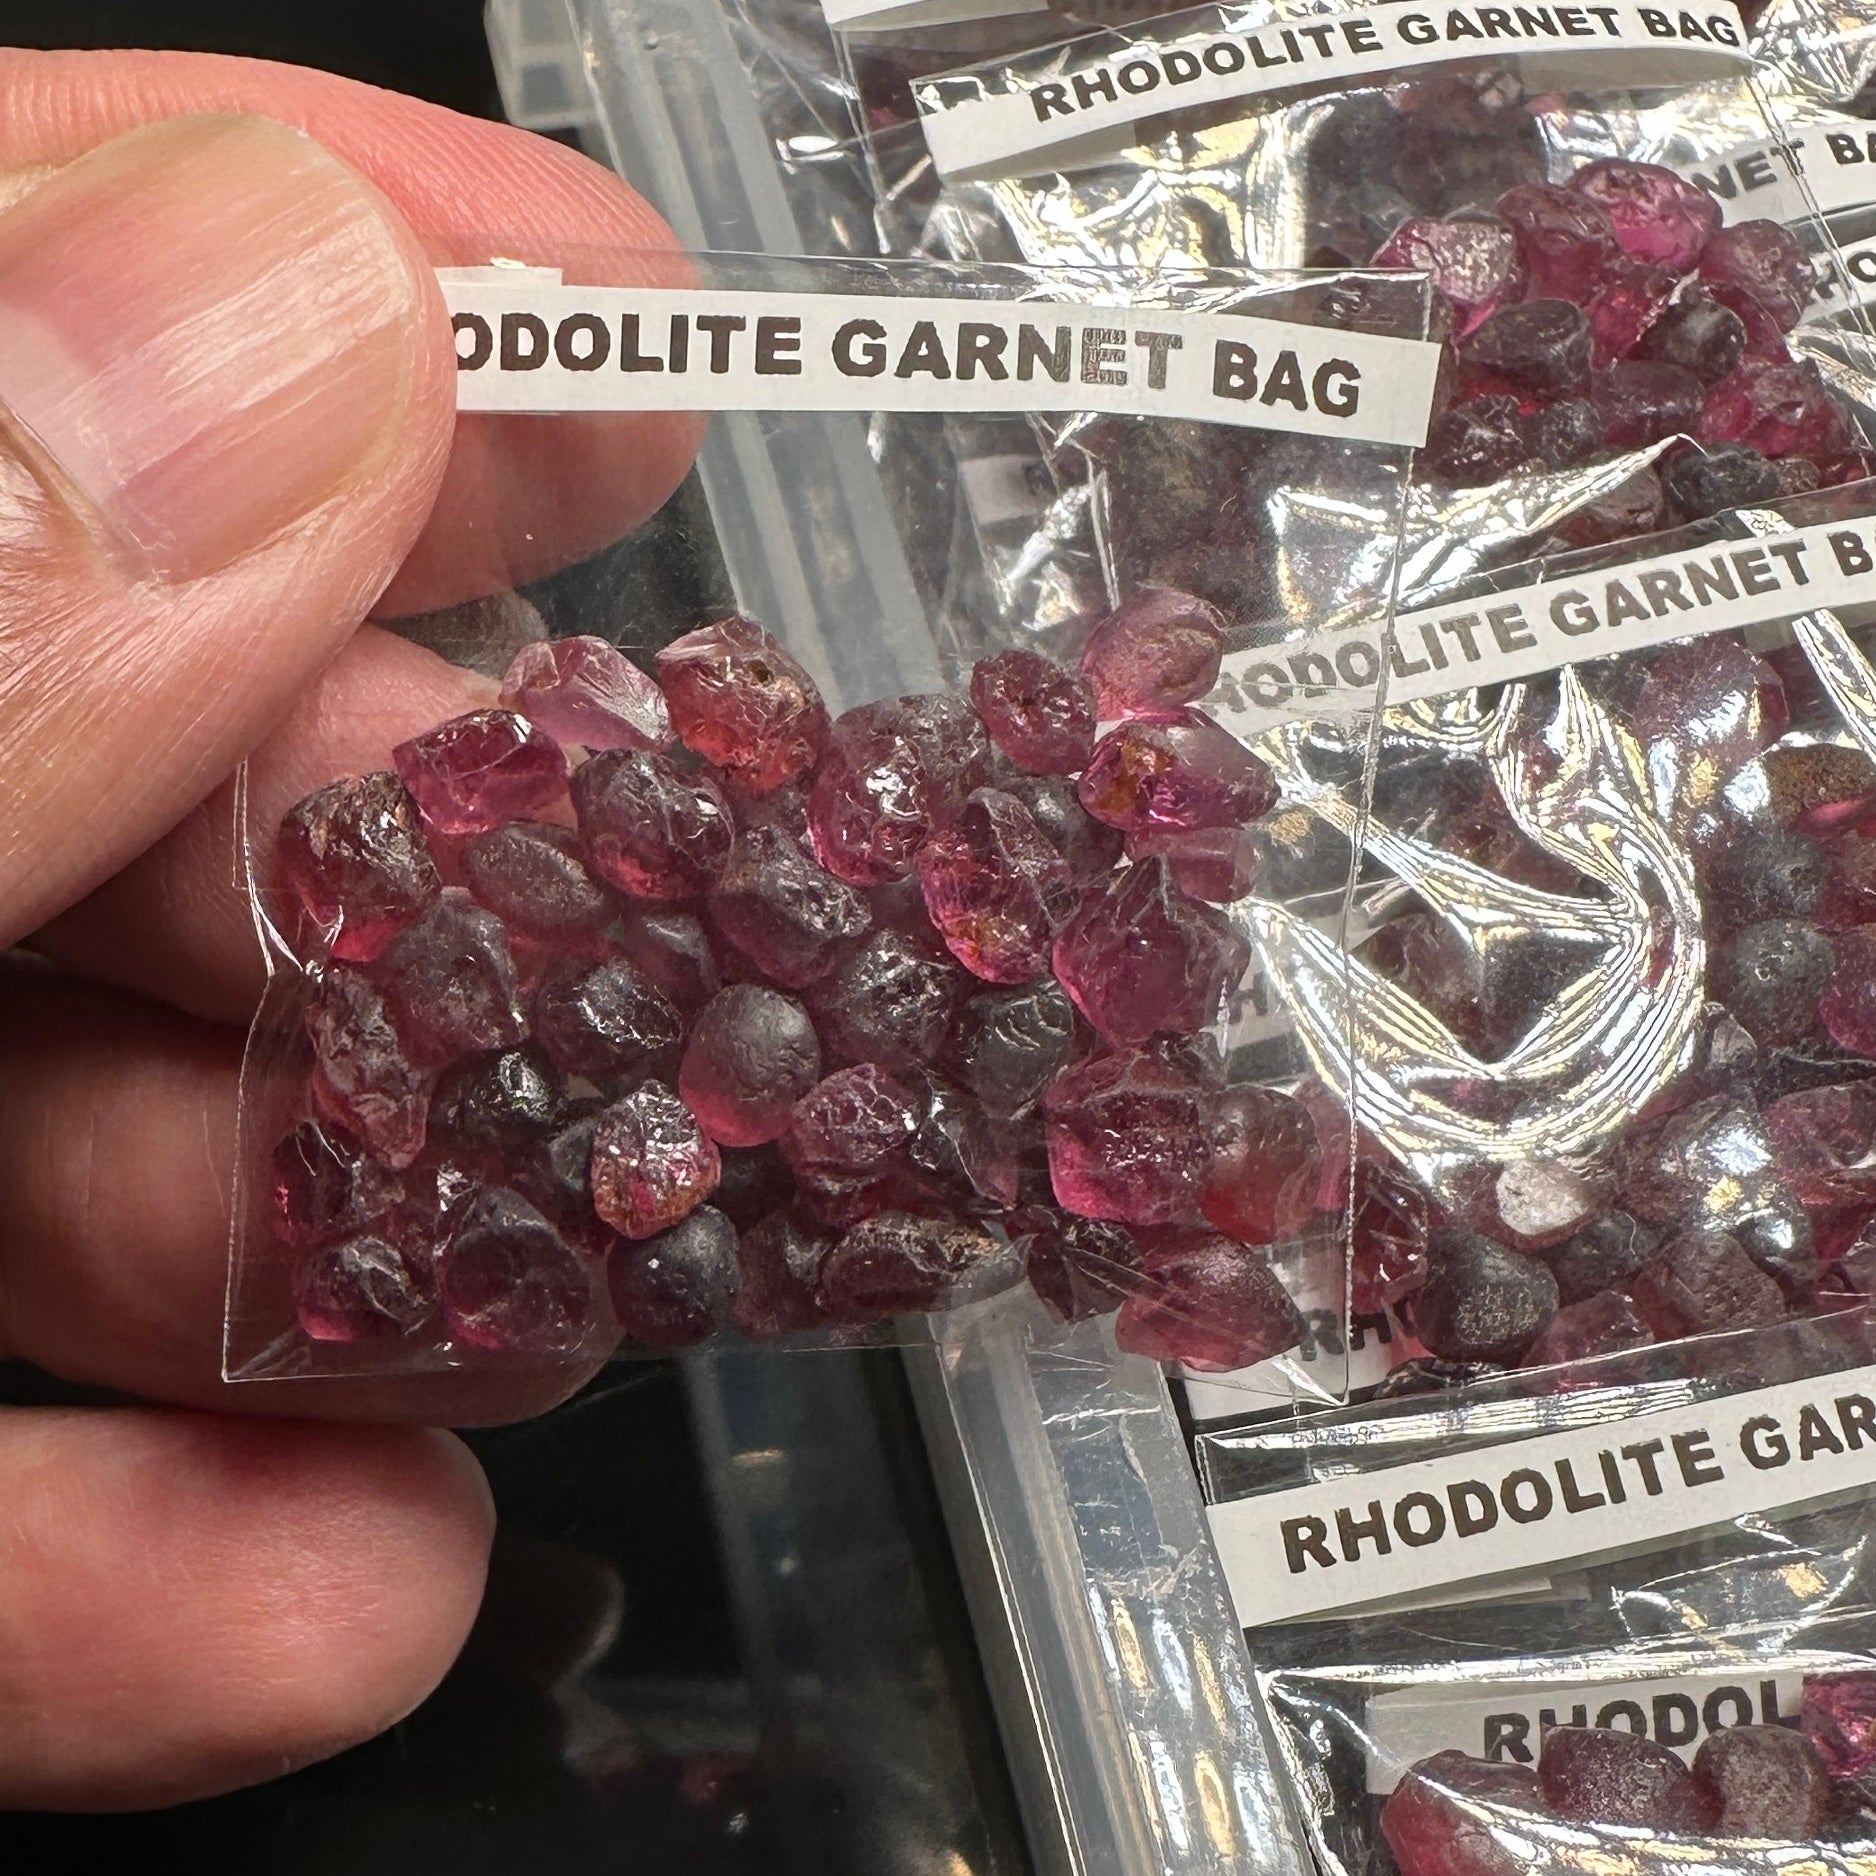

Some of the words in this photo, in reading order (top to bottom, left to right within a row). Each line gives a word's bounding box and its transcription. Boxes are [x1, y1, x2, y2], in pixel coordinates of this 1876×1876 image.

[1029, 19, 1384, 122] RHODOLITE
[1397, 8, 1623, 46] GARNET
[1638, 8, 1741, 47] BAG
[1825, 131, 1876, 165] B
[831, 318, 1184, 390] GARNET
[1212, 339, 1362, 417] BAG
[1550, 538, 1810, 636] GARNET
[1826, 530, 1876, 576] B
[1280, 1427, 1725, 1574] RHODOLITE
[1740, 1393, 1876, 1470] GAR
